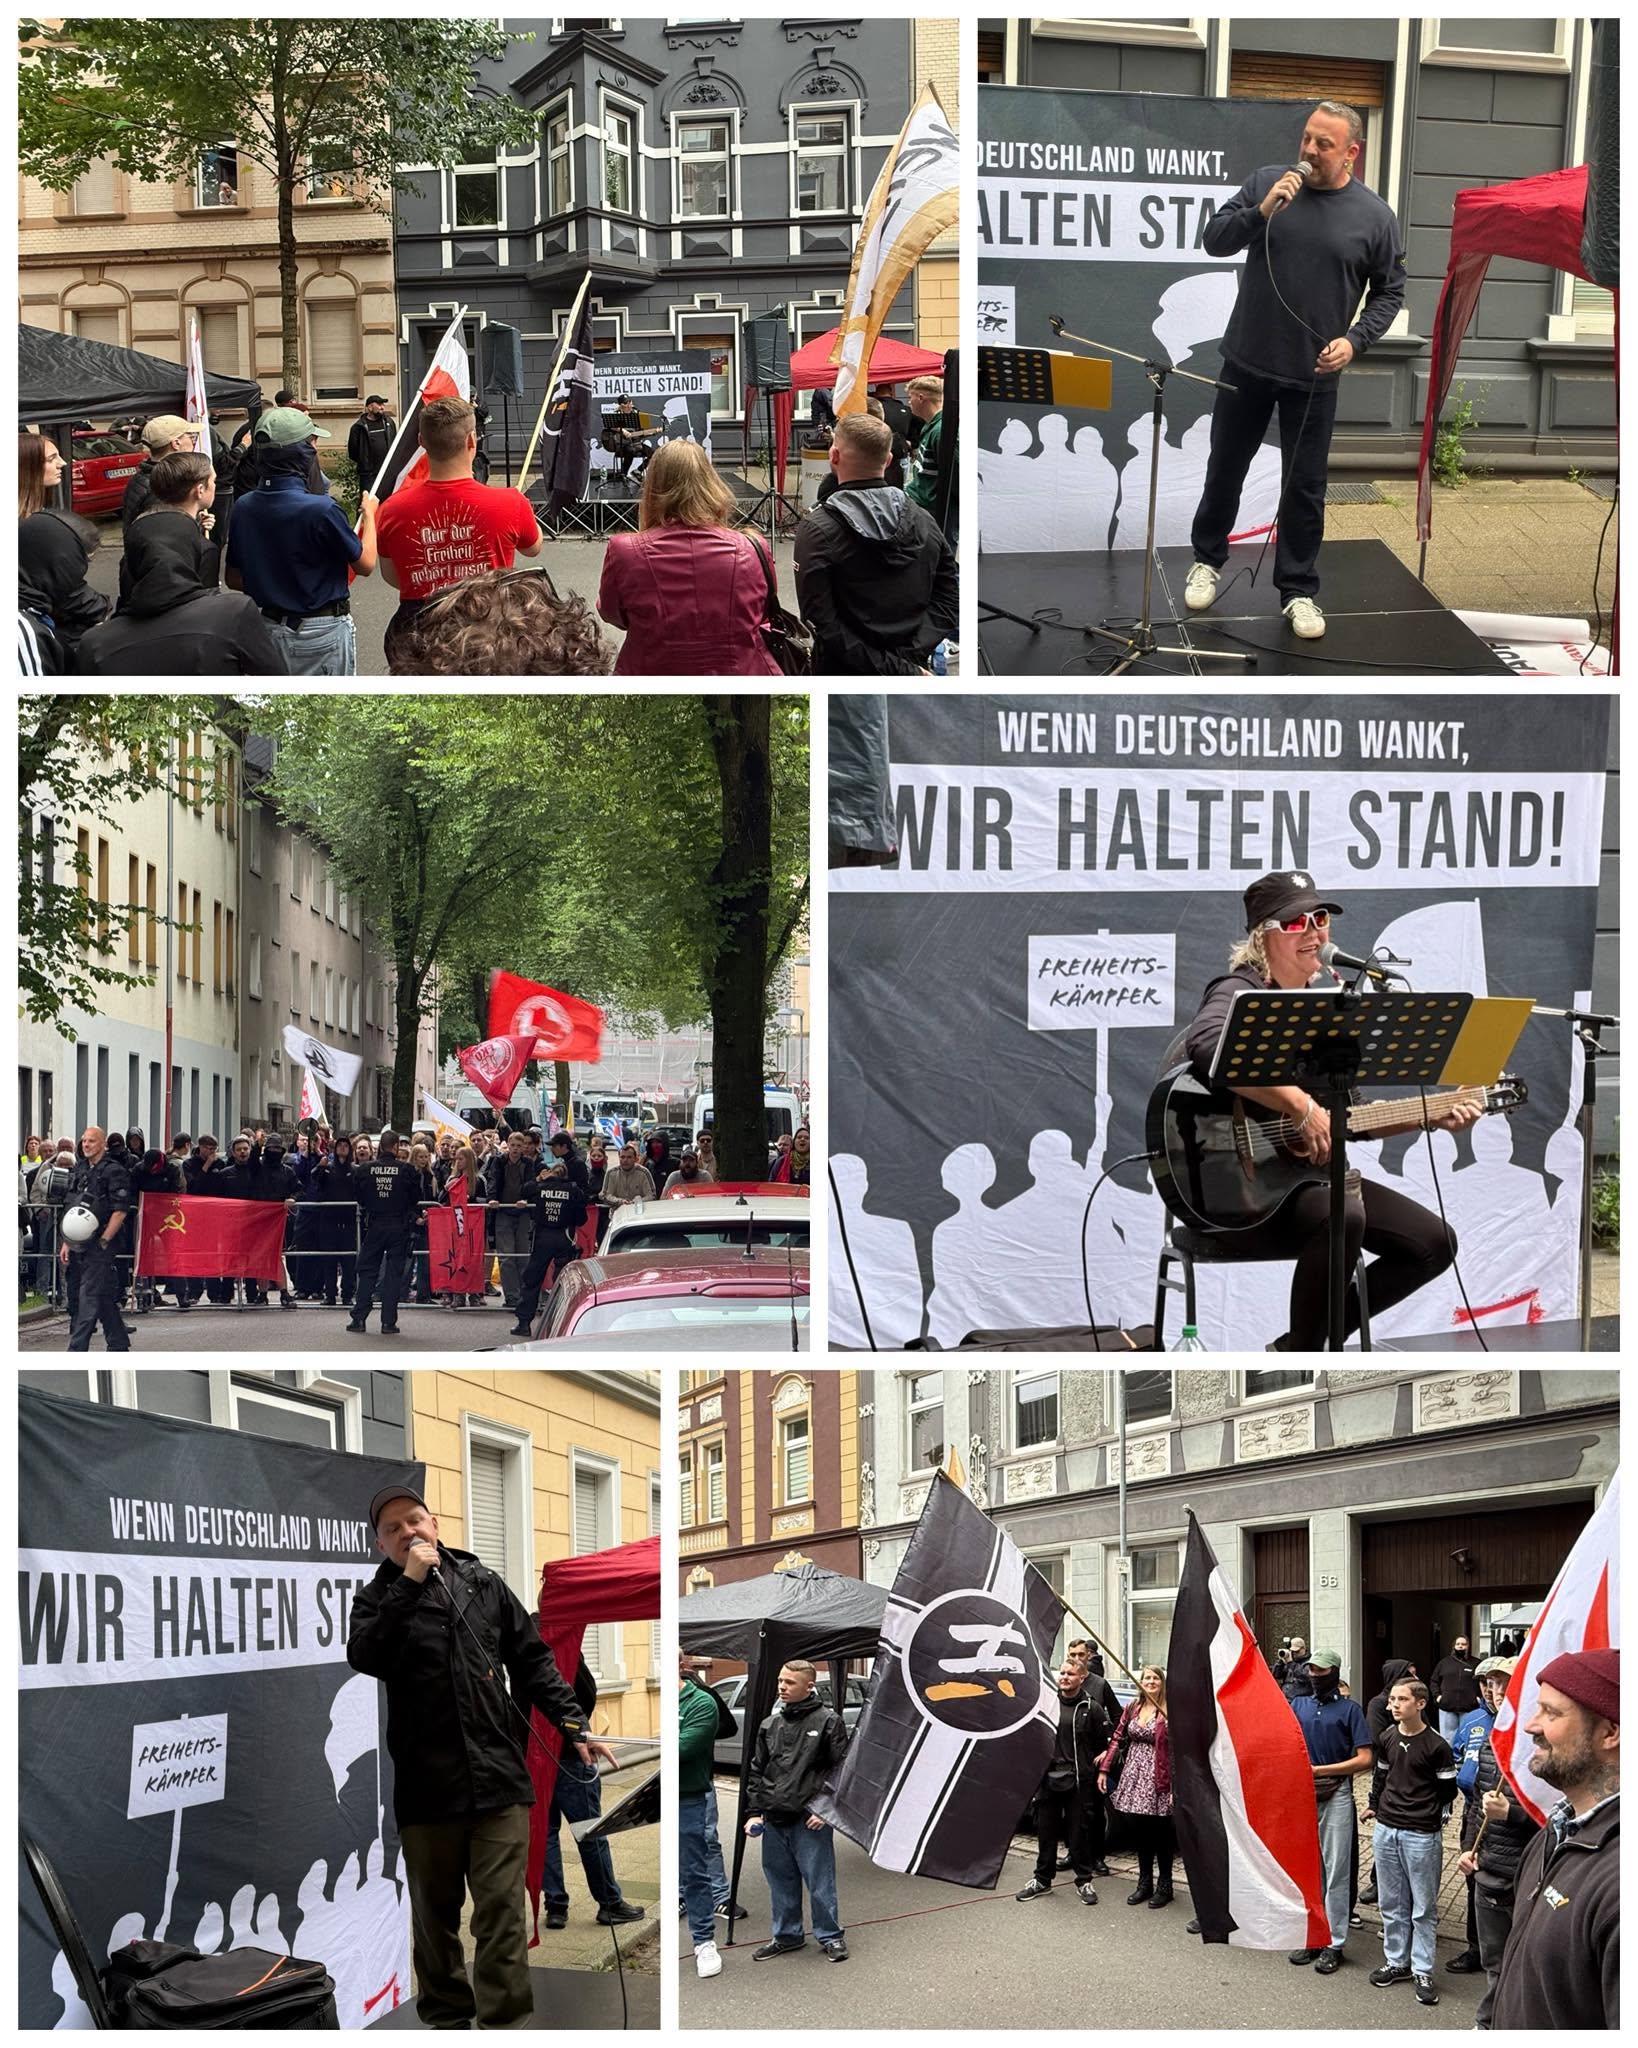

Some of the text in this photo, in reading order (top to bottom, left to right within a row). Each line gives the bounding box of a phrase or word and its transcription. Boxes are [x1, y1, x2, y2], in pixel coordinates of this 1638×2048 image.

[1146, 148, 1229, 181] WANKT,
[594, 367, 612, 376] WENN
[614, 365, 657, 375] DEUTSCHLAND
[605, 378, 651, 394] HALTEN
[658, 376, 703, 392] STAND!
[425, 544, 473, 563] Freiheit
[998, 711, 1469, 766] WENN DEUTSCHLAND WANKT,
[880, 784, 1565, 871] WIR HALTEN STAND!
[1038, 957, 1168, 979] FREIHEITS-
[1049, 983, 1161, 1007] KÄMPFER
[370, 1166, 399, 1175] POLIZEI
[541, 1190, 570, 1200] POLIZEI
[109, 1497, 371, 1558] WENN DEUTSCHLAND WANKT,
[1320, 1574, 1338, 1588] 66
[18, 1570, 125, 1666] WIR
[152, 1575, 299, 1659] HALTEN
[138, 1736, 222, 1767] FREIHEITS-
[144, 1765, 218, 1794] KÄMPFER
